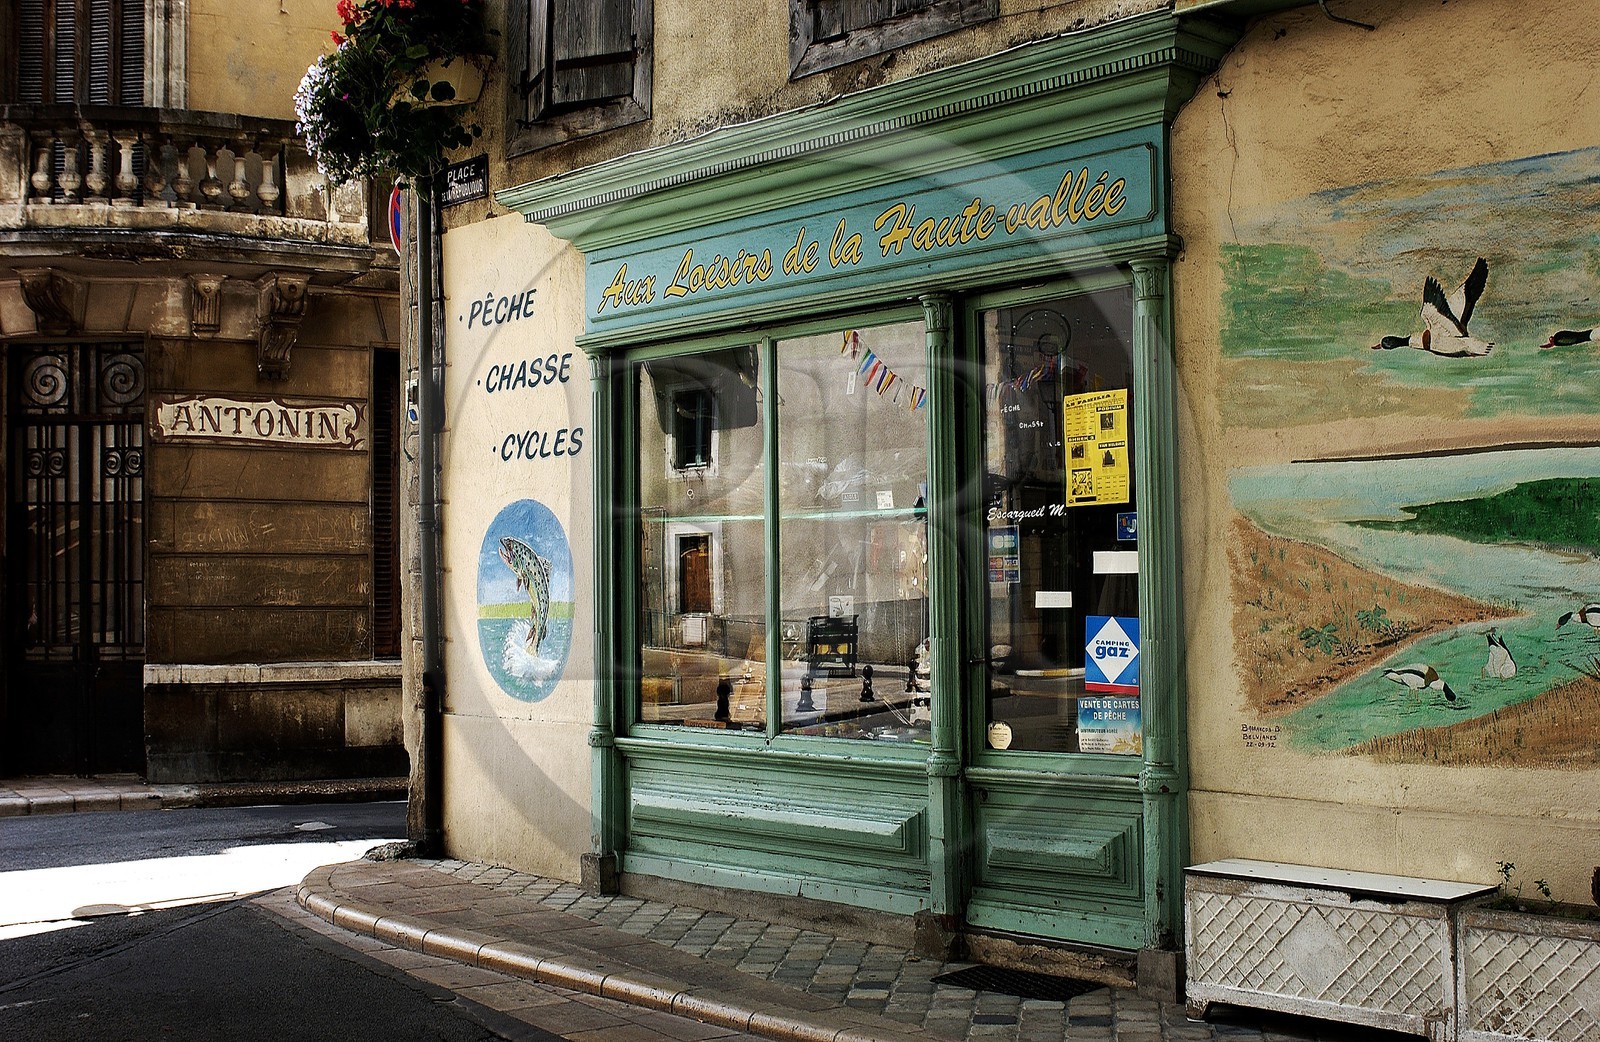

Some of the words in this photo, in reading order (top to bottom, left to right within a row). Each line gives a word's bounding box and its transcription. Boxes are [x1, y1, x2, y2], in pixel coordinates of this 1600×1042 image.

[447, 164, 476, 183] PLACE
[598, 263, 656, 313] Aux
[663, 248, 774, 300] Loisirs
[783, 226, 820, 276] de
[828, 219, 864, 268] la
[873, 166, 1127, 256] Haute-vallée
[468, 287, 536, 330] PÊCHE
[486, 354, 573, 393] CHASSE
[171, 405, 345, 441] ANTONIN
[502, 427, 584, 462] CYCLES
[986, 505, 1046, 522] Escargueil
[1048, 503, 1067, 517] M.
[1095, 639, 1130, 647] CAMPING
[1095, 646, 1129, 660] gaz
[1079, 700, 1101, 709] VENTE
[1102, 700, 1112, 709] DE
[1113, 700, 1140, 709] CARTES
[1093, 711, 1102, 720] DE
[1104, 710, 1127, 720] PÊCHE
